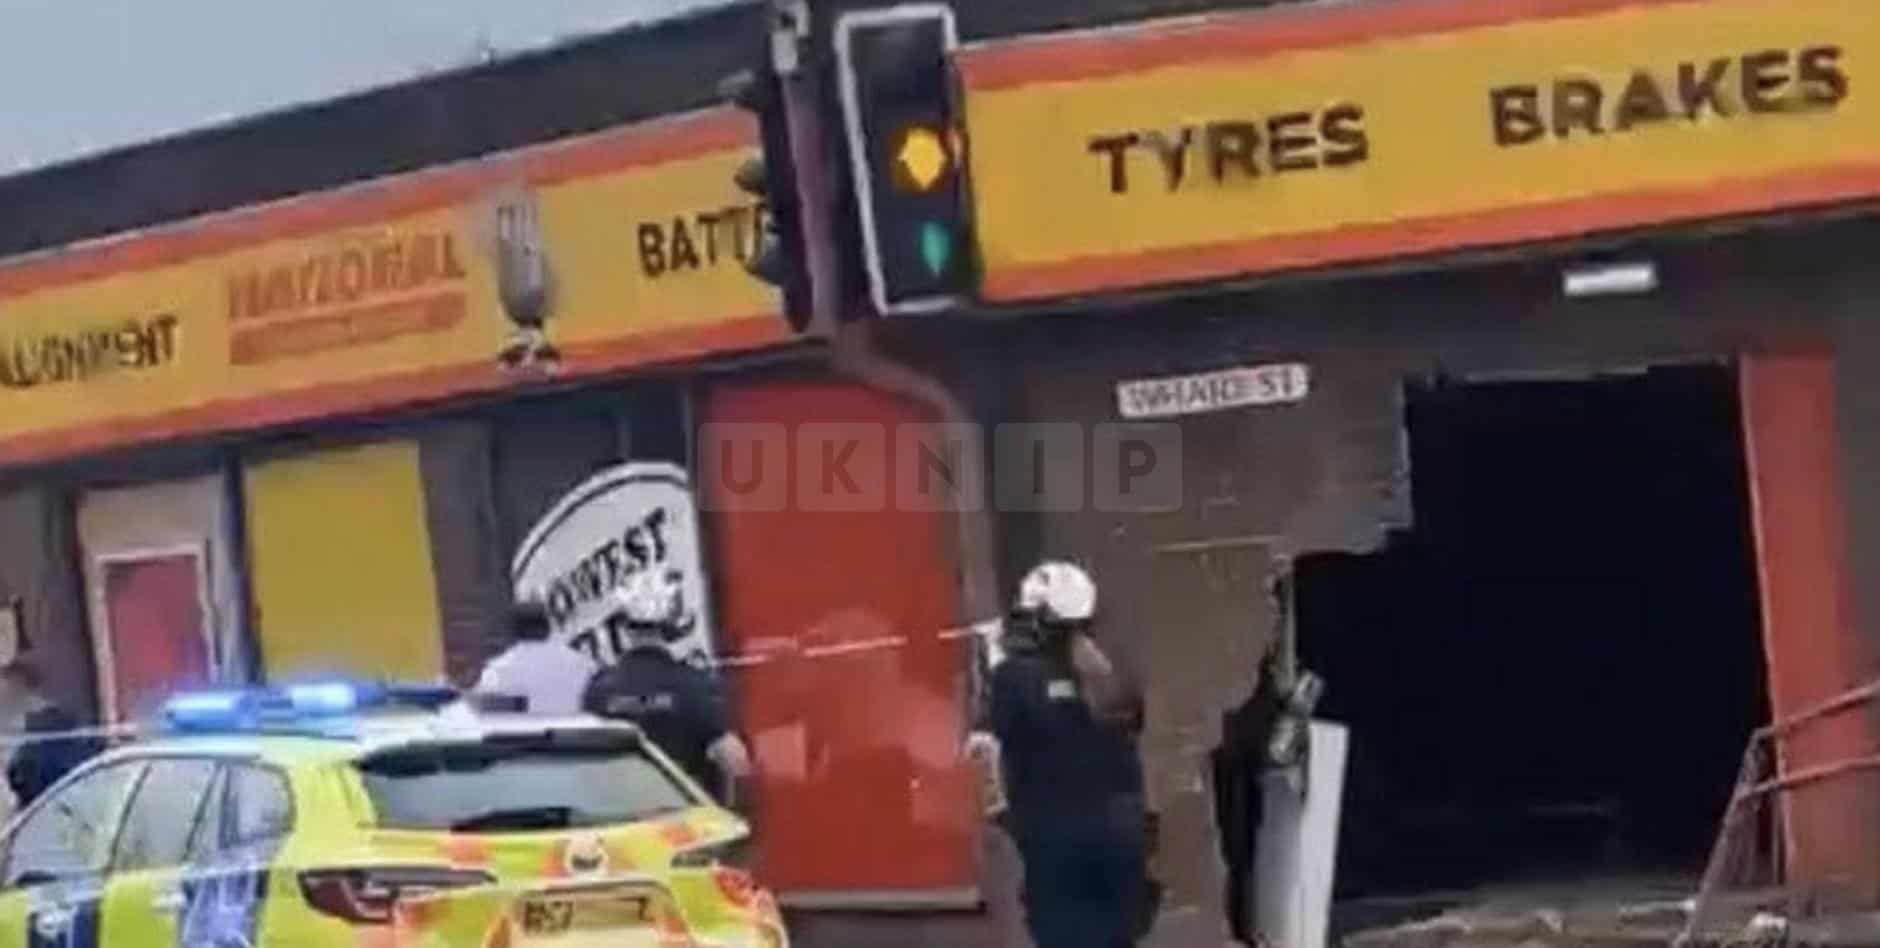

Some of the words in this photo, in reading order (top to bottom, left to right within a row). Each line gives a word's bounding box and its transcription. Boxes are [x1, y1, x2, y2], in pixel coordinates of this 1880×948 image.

[1088, 101, 1369, 194] TYRES
[1489, 44, 1849, 147] BRAKES
[545, 506, 666, 627] OWEST
